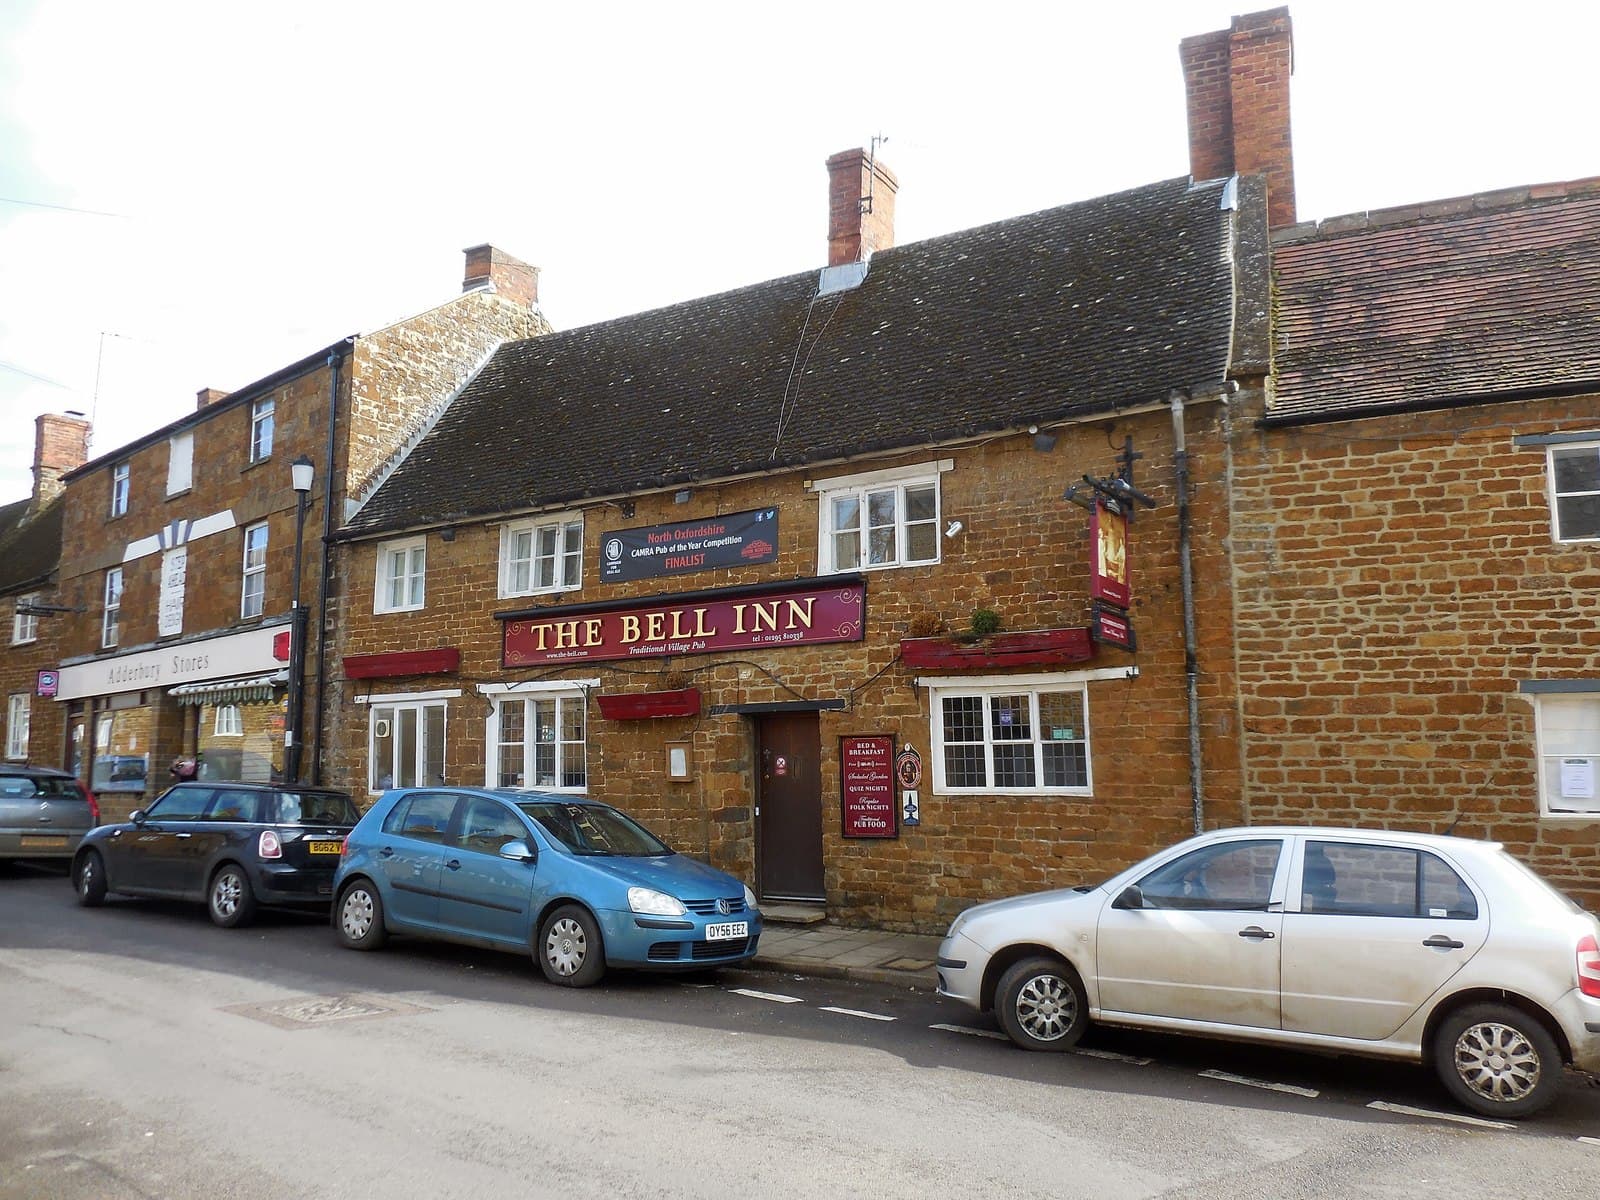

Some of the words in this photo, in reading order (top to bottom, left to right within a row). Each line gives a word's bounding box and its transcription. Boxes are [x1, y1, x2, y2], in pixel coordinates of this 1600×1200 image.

[648, 531, 672, 544] North
[674, 524, 726, 540] Oxfordshire
[631, 547, 654, 558] CAMRA
[655, 546, 668, 555] Pub
[669, 543, 676, 552] of
[677, 543, 687, 551] the
[687, 541, 701, 550] Year
[703, 535, 743, 548] Competition
[665, 553, 706, 569] FINALIST
[530, 619, 604, 651] THE
[619, 608, 717, 644] BELL
[732, 597, 817, 635] INN
[628, 643, 667, 655] Traditional
[667, 641, 691, 654] Village
[691, 640, 706, 650] Pub
[109, 664, 160, 684] Adderbury
[173, 655, 208, 674] Stores
[710, 925, 731, 937] OY56
[732, 924, 744, 935] EEZ
